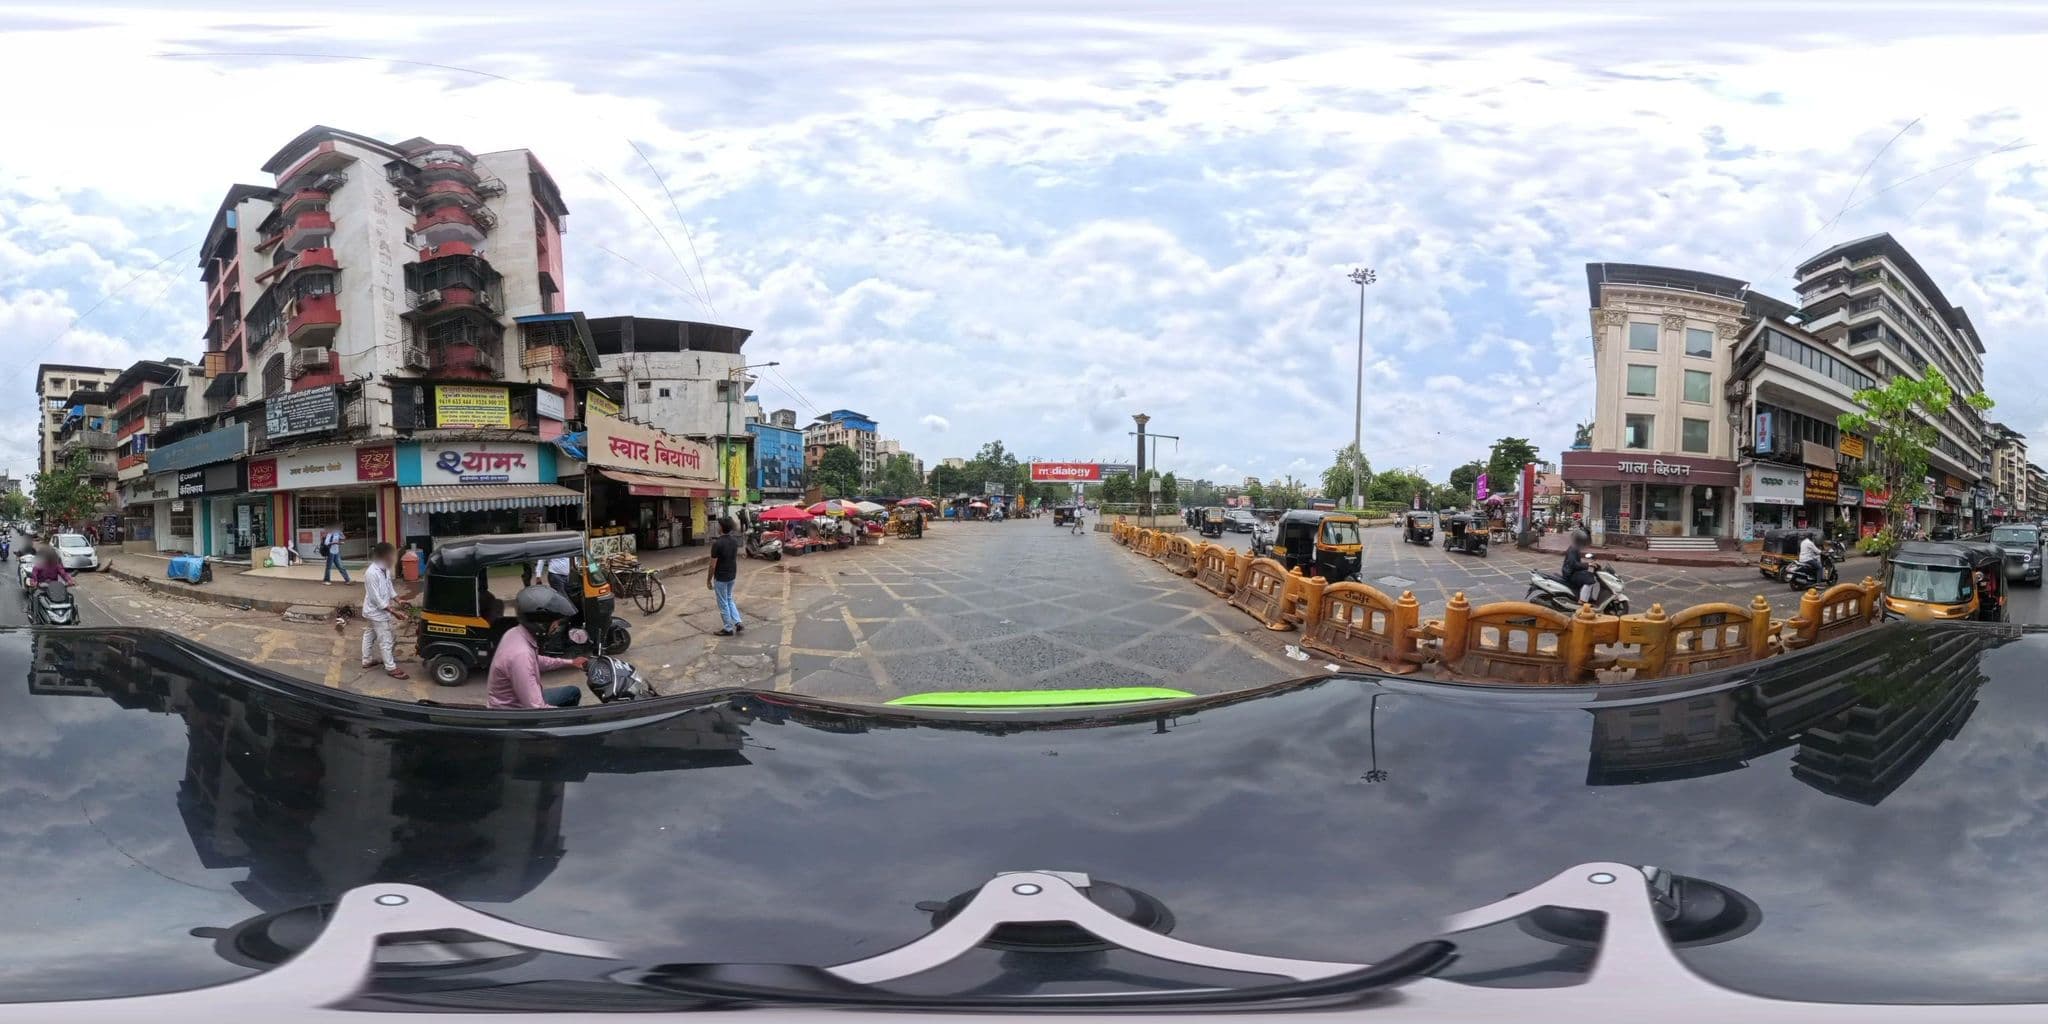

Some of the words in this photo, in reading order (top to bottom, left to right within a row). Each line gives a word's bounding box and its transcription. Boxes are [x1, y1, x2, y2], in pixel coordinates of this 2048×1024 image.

[608, 436, 650, 464] स्वाद
[655, 440, 700, 470] बिर्याणी
[1618, 461, 1648, 474] गाला
[1653, 459, 1691, 476] व्हिजन
[1761, 477, 1783, 486] oppo
